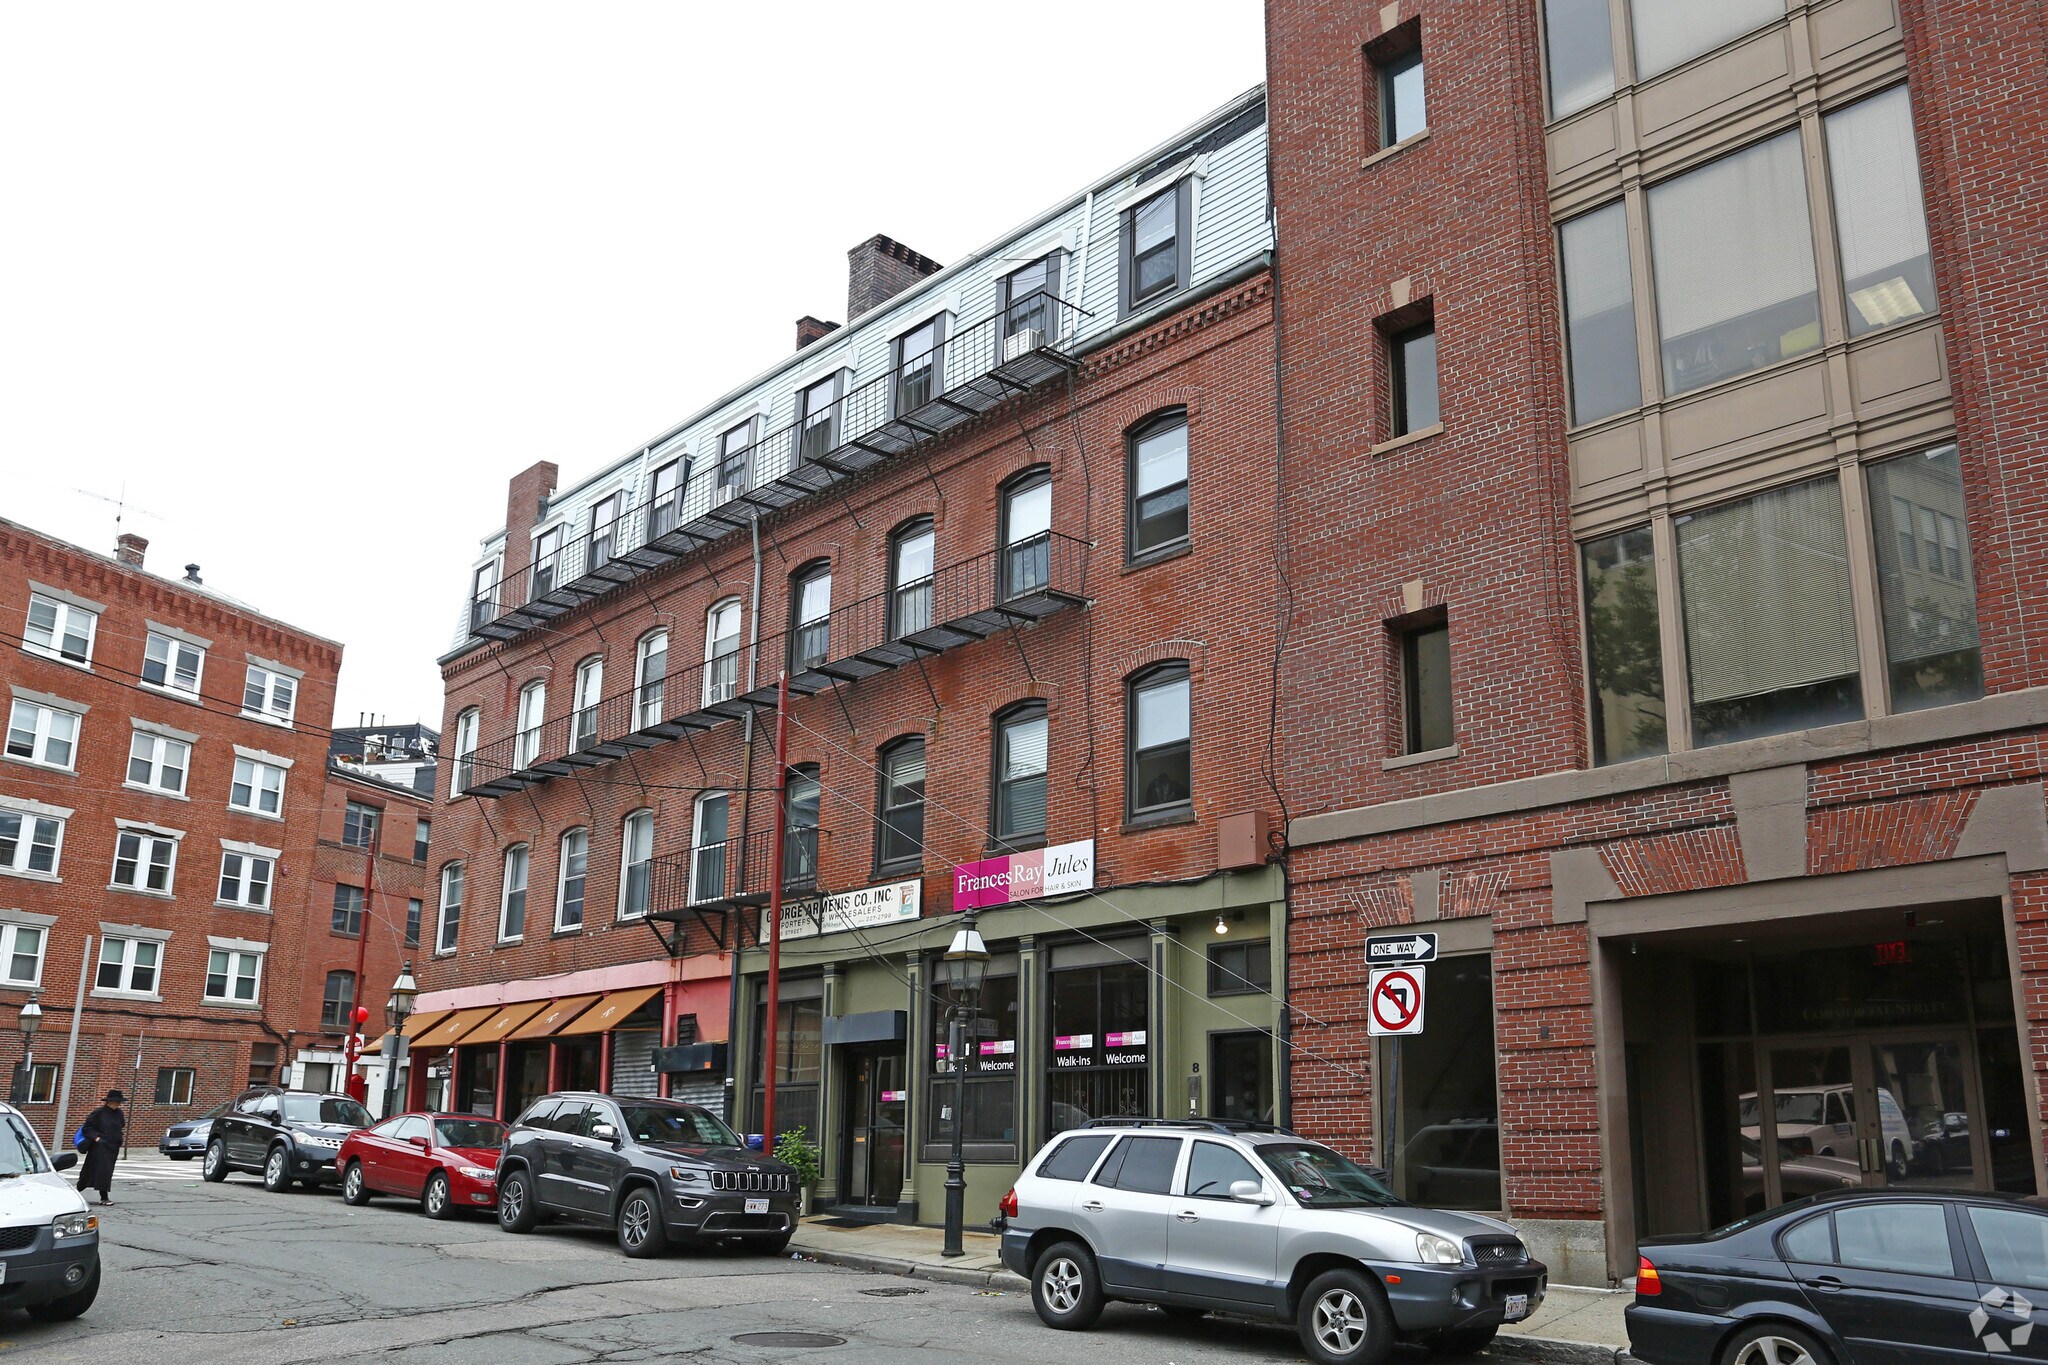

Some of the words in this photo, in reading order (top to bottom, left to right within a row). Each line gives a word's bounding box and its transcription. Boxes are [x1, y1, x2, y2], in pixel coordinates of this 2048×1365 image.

[957, 871, 1012, 893] Frances
[1014, 864, 1044, 885] Ray
[1048, 855, 1089, 877] Jules
[1009, 890, 1030, 898] SALON
[1031, 886, 1044, 896] FOR
[1045, 884, 1059, 893] HAIR
[1067, 880, 1082, 889] SKIN
[766, 904, 803, 923] GORGE
[874, 888, 894, 904] INC.
[1373, 944, 1392, 954] ONE
[1396, 943, 1416, 953] WAY
[980, 1060, 1014, 1071] Welcome
[1057, 1055, 1091, 1067] Walk-Ins
[1106, 1052, 1146, 1064] Welcome
[1192, 1062, 1200, 1073] 8
